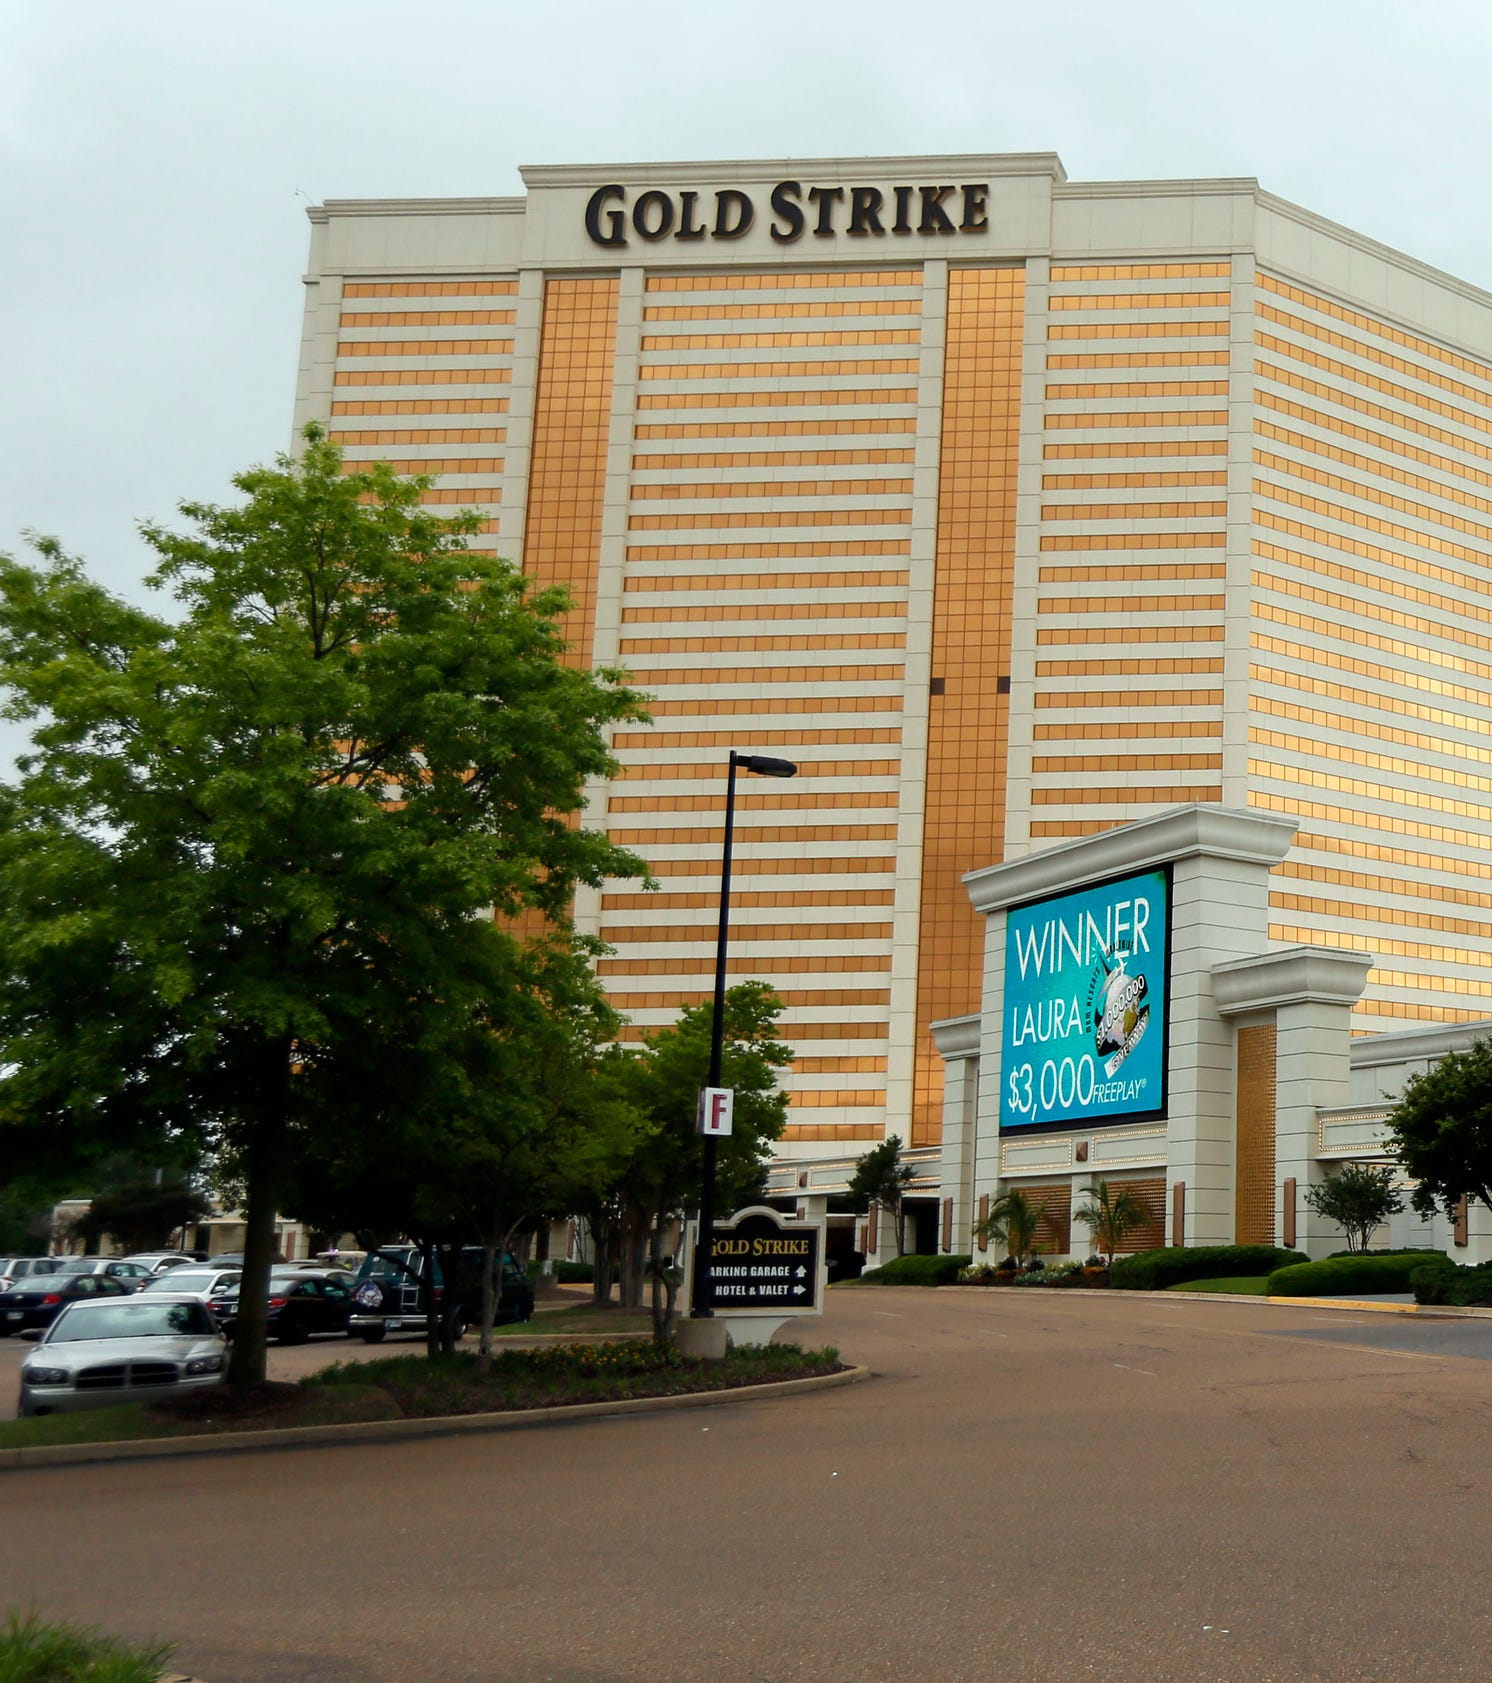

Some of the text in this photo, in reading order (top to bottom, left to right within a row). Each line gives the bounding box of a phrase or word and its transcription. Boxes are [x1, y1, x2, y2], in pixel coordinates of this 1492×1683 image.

[584, 180, 990, 248] GOLD STRIKE
[1015, 897, 1150, 981] WINNER
[1012, 994, 1083, 1046] LAURA
[1008, 1053, 1095, 1121] $3,000
[711, 1093, 727, 1129] F
[752, 1237, 809, 1256] STRIKE
[710, 1266, 790, 1277] ARKING GARAGE
[715, 1285, 789, 1295] HOTEL & VALET
